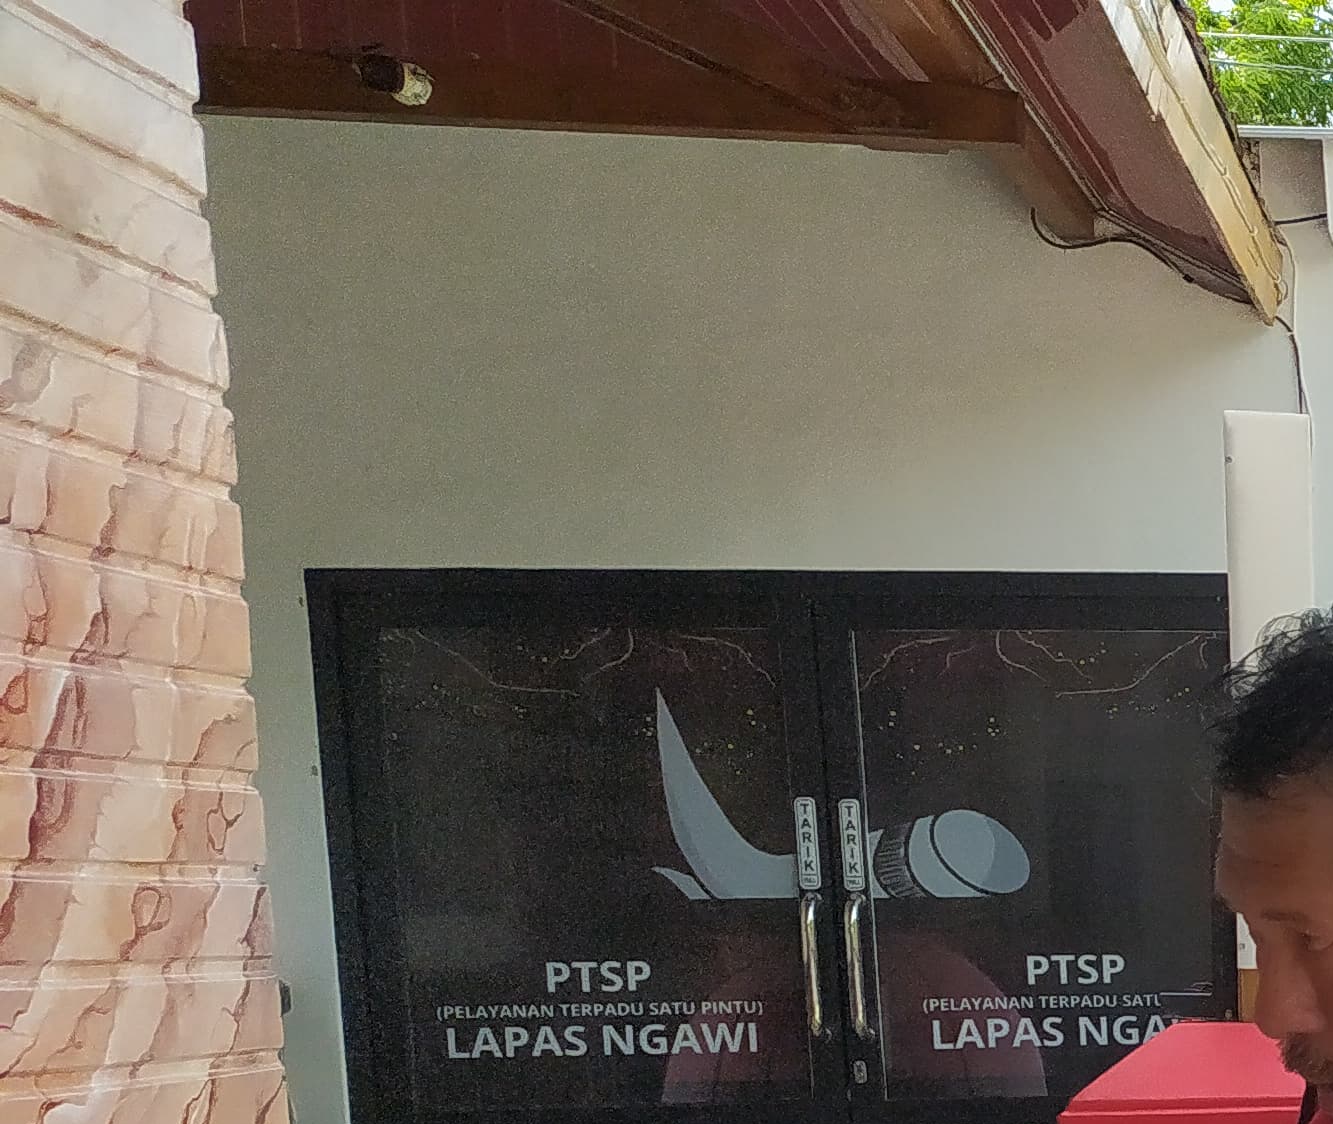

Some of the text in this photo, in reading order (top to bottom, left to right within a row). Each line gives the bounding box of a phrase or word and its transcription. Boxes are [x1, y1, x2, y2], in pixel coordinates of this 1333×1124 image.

[800, 803, 815, 872] TARIK
[845, 805, 859, 874] TARIK
[546, 960, 651, 993] PTSP
[1026, 954, 1126, 985] PTSP
[436, 1000, 763, 1022] (PELAYANAN TERPADU SATU PINTU)
[922, 996, 1034, 1014] (PELAYANAN
[1038, 995, 1118, 1010] TERPADU
[446, 1022, 759, 1060] LAPAS NGAWI
[931, 1014, 1178, 1051] LAPAS NGA
